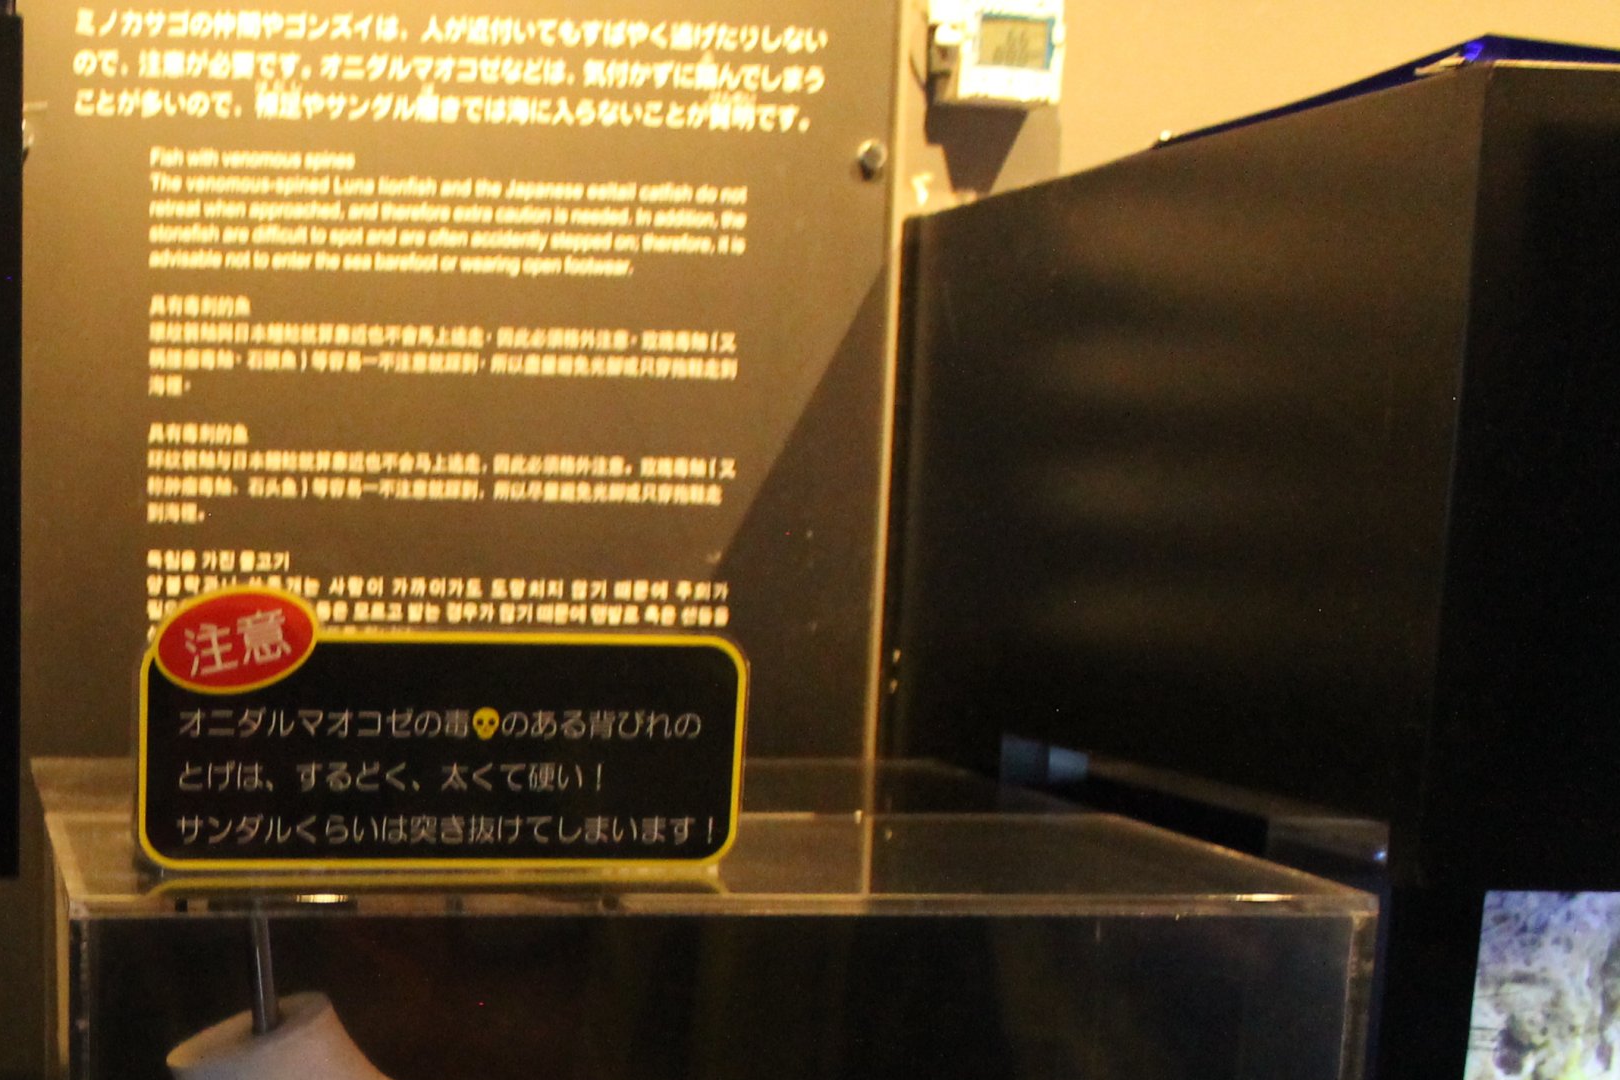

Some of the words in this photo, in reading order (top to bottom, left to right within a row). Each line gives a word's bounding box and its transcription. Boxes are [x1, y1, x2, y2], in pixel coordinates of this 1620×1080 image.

[182, 608, 292, 678] 注意
[176, 812, 716, 848] サンダルくらいは突き抜けてしまいます！
